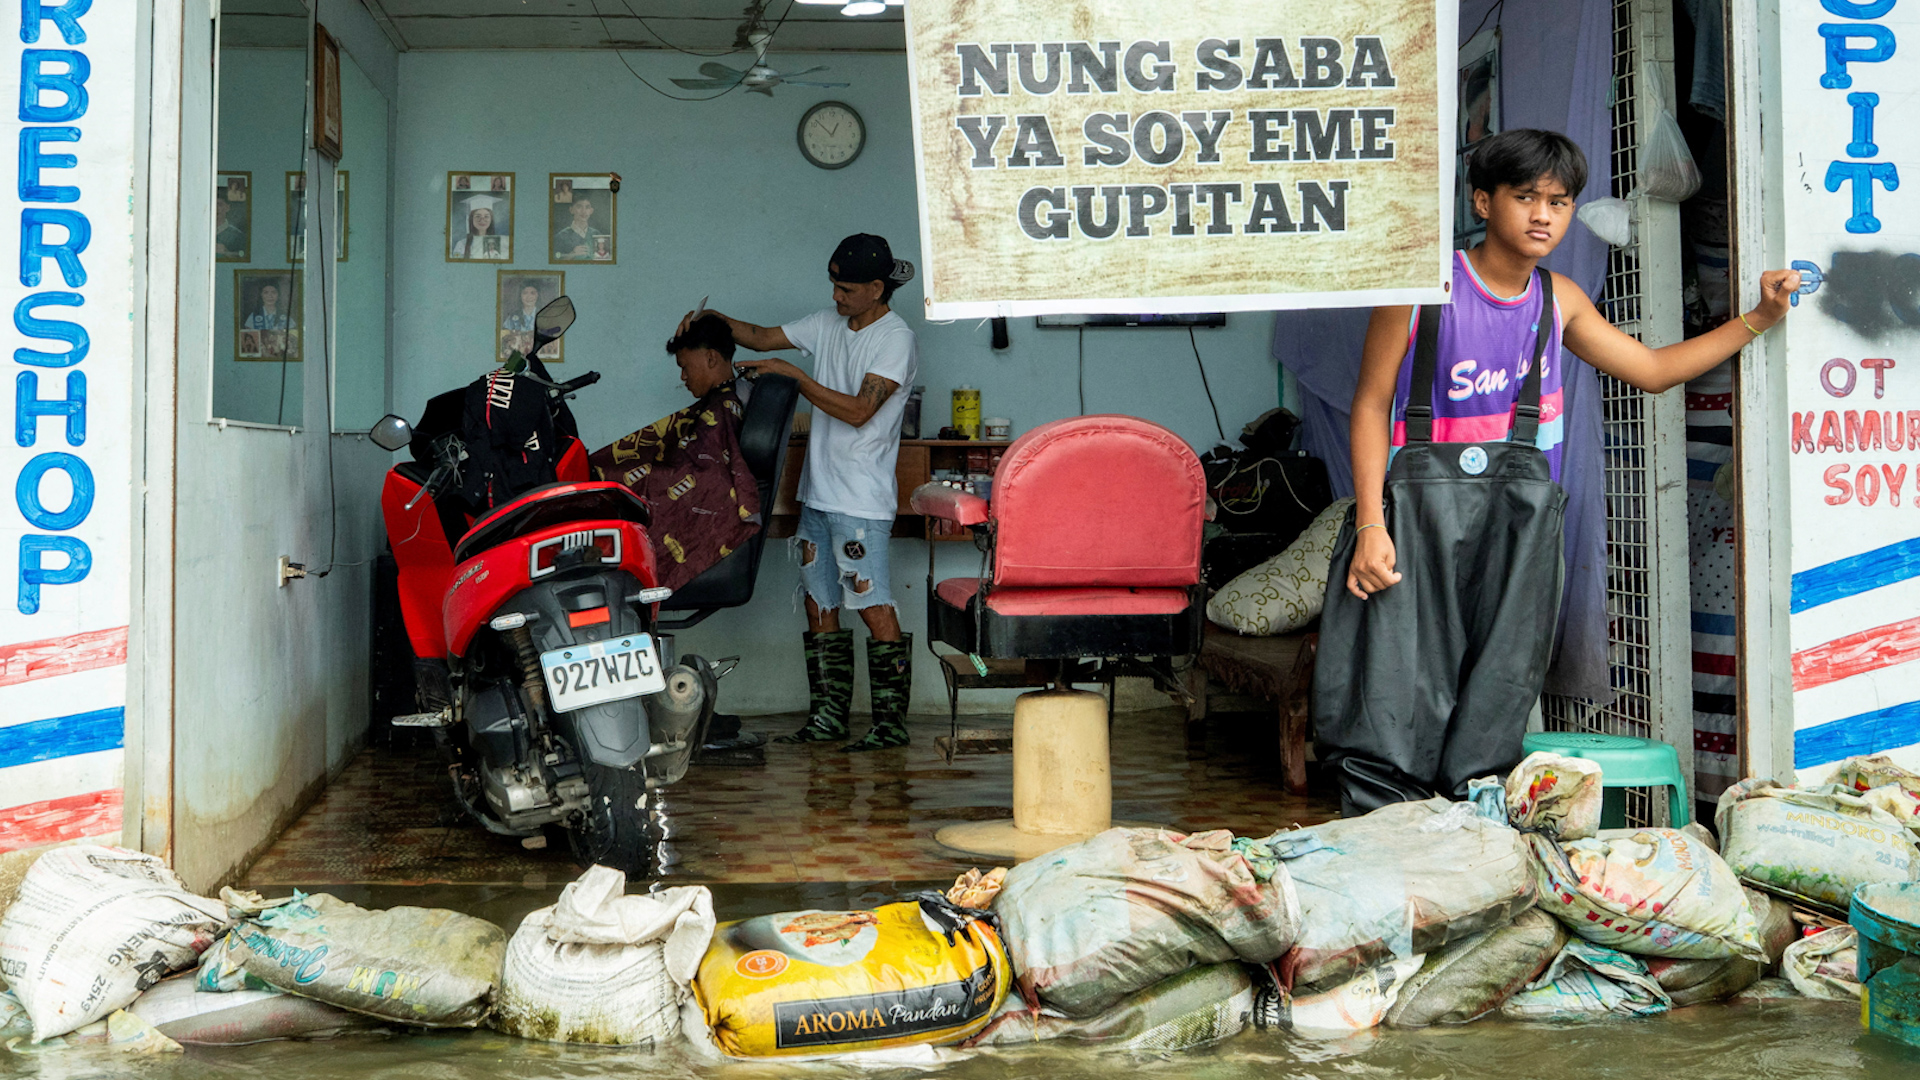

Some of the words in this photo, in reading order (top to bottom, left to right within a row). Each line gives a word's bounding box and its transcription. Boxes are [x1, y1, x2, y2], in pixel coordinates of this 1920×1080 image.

[956, 40, 1176, 96] NUNG
[1195, 35, 1397, 93] SABA
[955, 114, 1065, 168] YA
[1083, 110, 1233, 168] SOY
[1247, 108, 1397, 163] EME
[1018, 180, 1351, 241] GUPITAN
[1448, 359, 1510, 402] San
[1820, 357, 1896, 400] OT
[552, 649, 654, 696] 927WZC
[1786, 811, 1886, 843] MINDORO
[37, 942, 60, 982] QUALITY
[794, 1007, 887, 1035] AROMA
[888, 998, 961, 1025] Pandan
